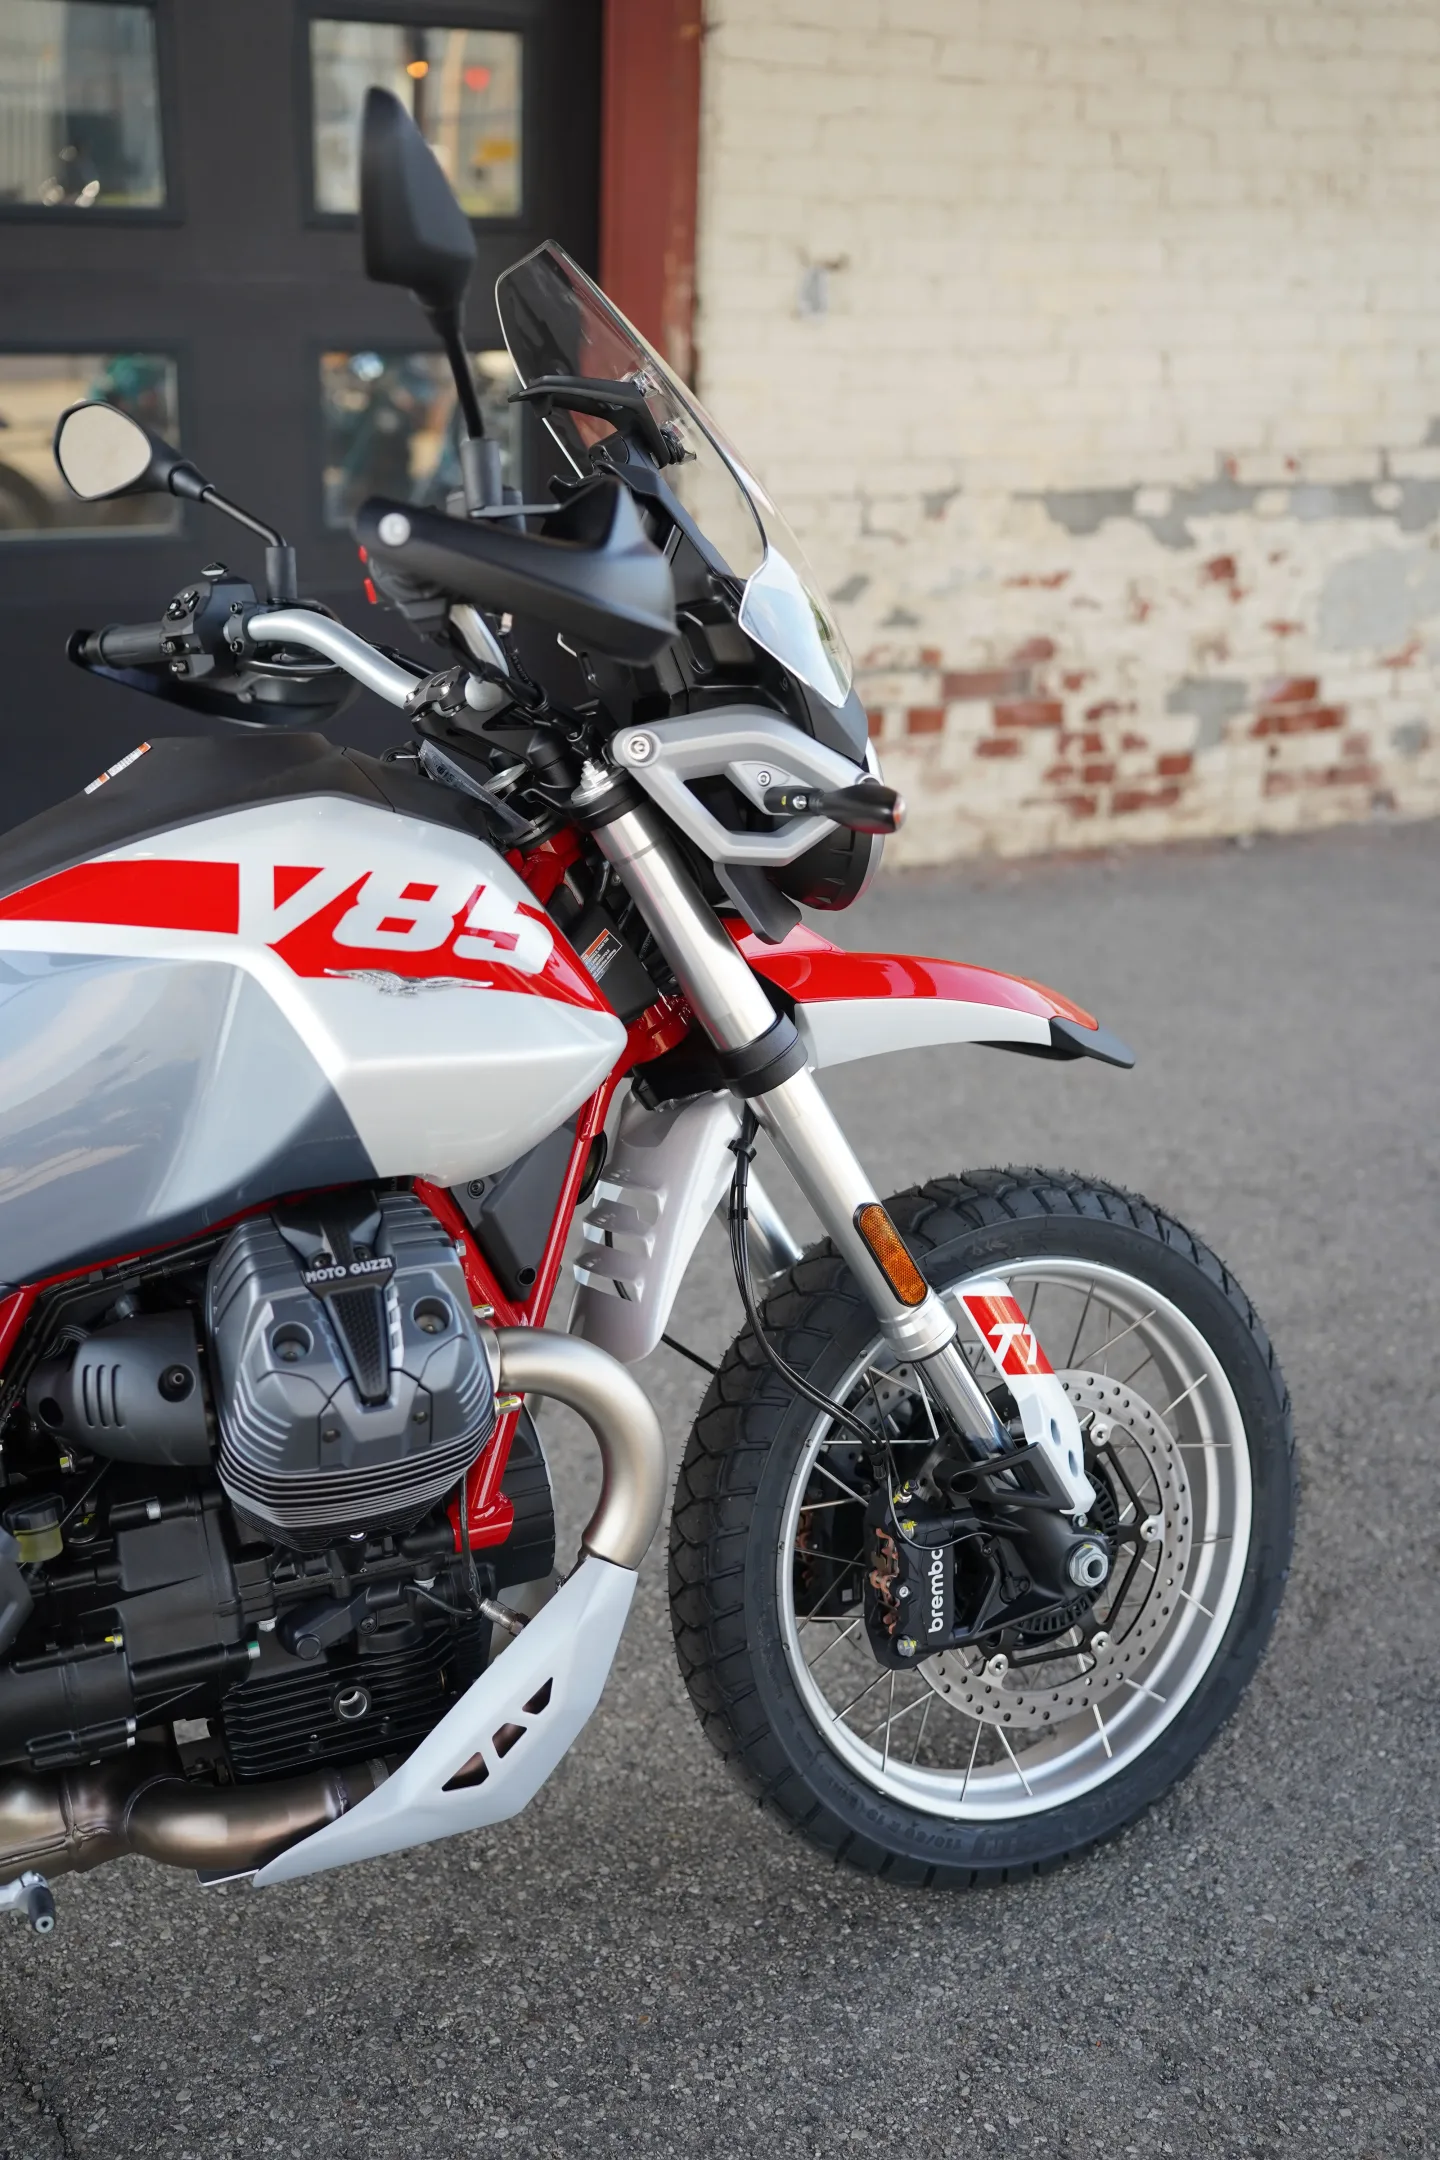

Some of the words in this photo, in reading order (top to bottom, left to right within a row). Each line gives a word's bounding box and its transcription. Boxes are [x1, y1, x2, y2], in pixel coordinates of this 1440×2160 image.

[238, 864, 554, 974] V85
[305, 1266, 347, 1283] MOTO
[349, 1257, 393, 1275] GUZZI
